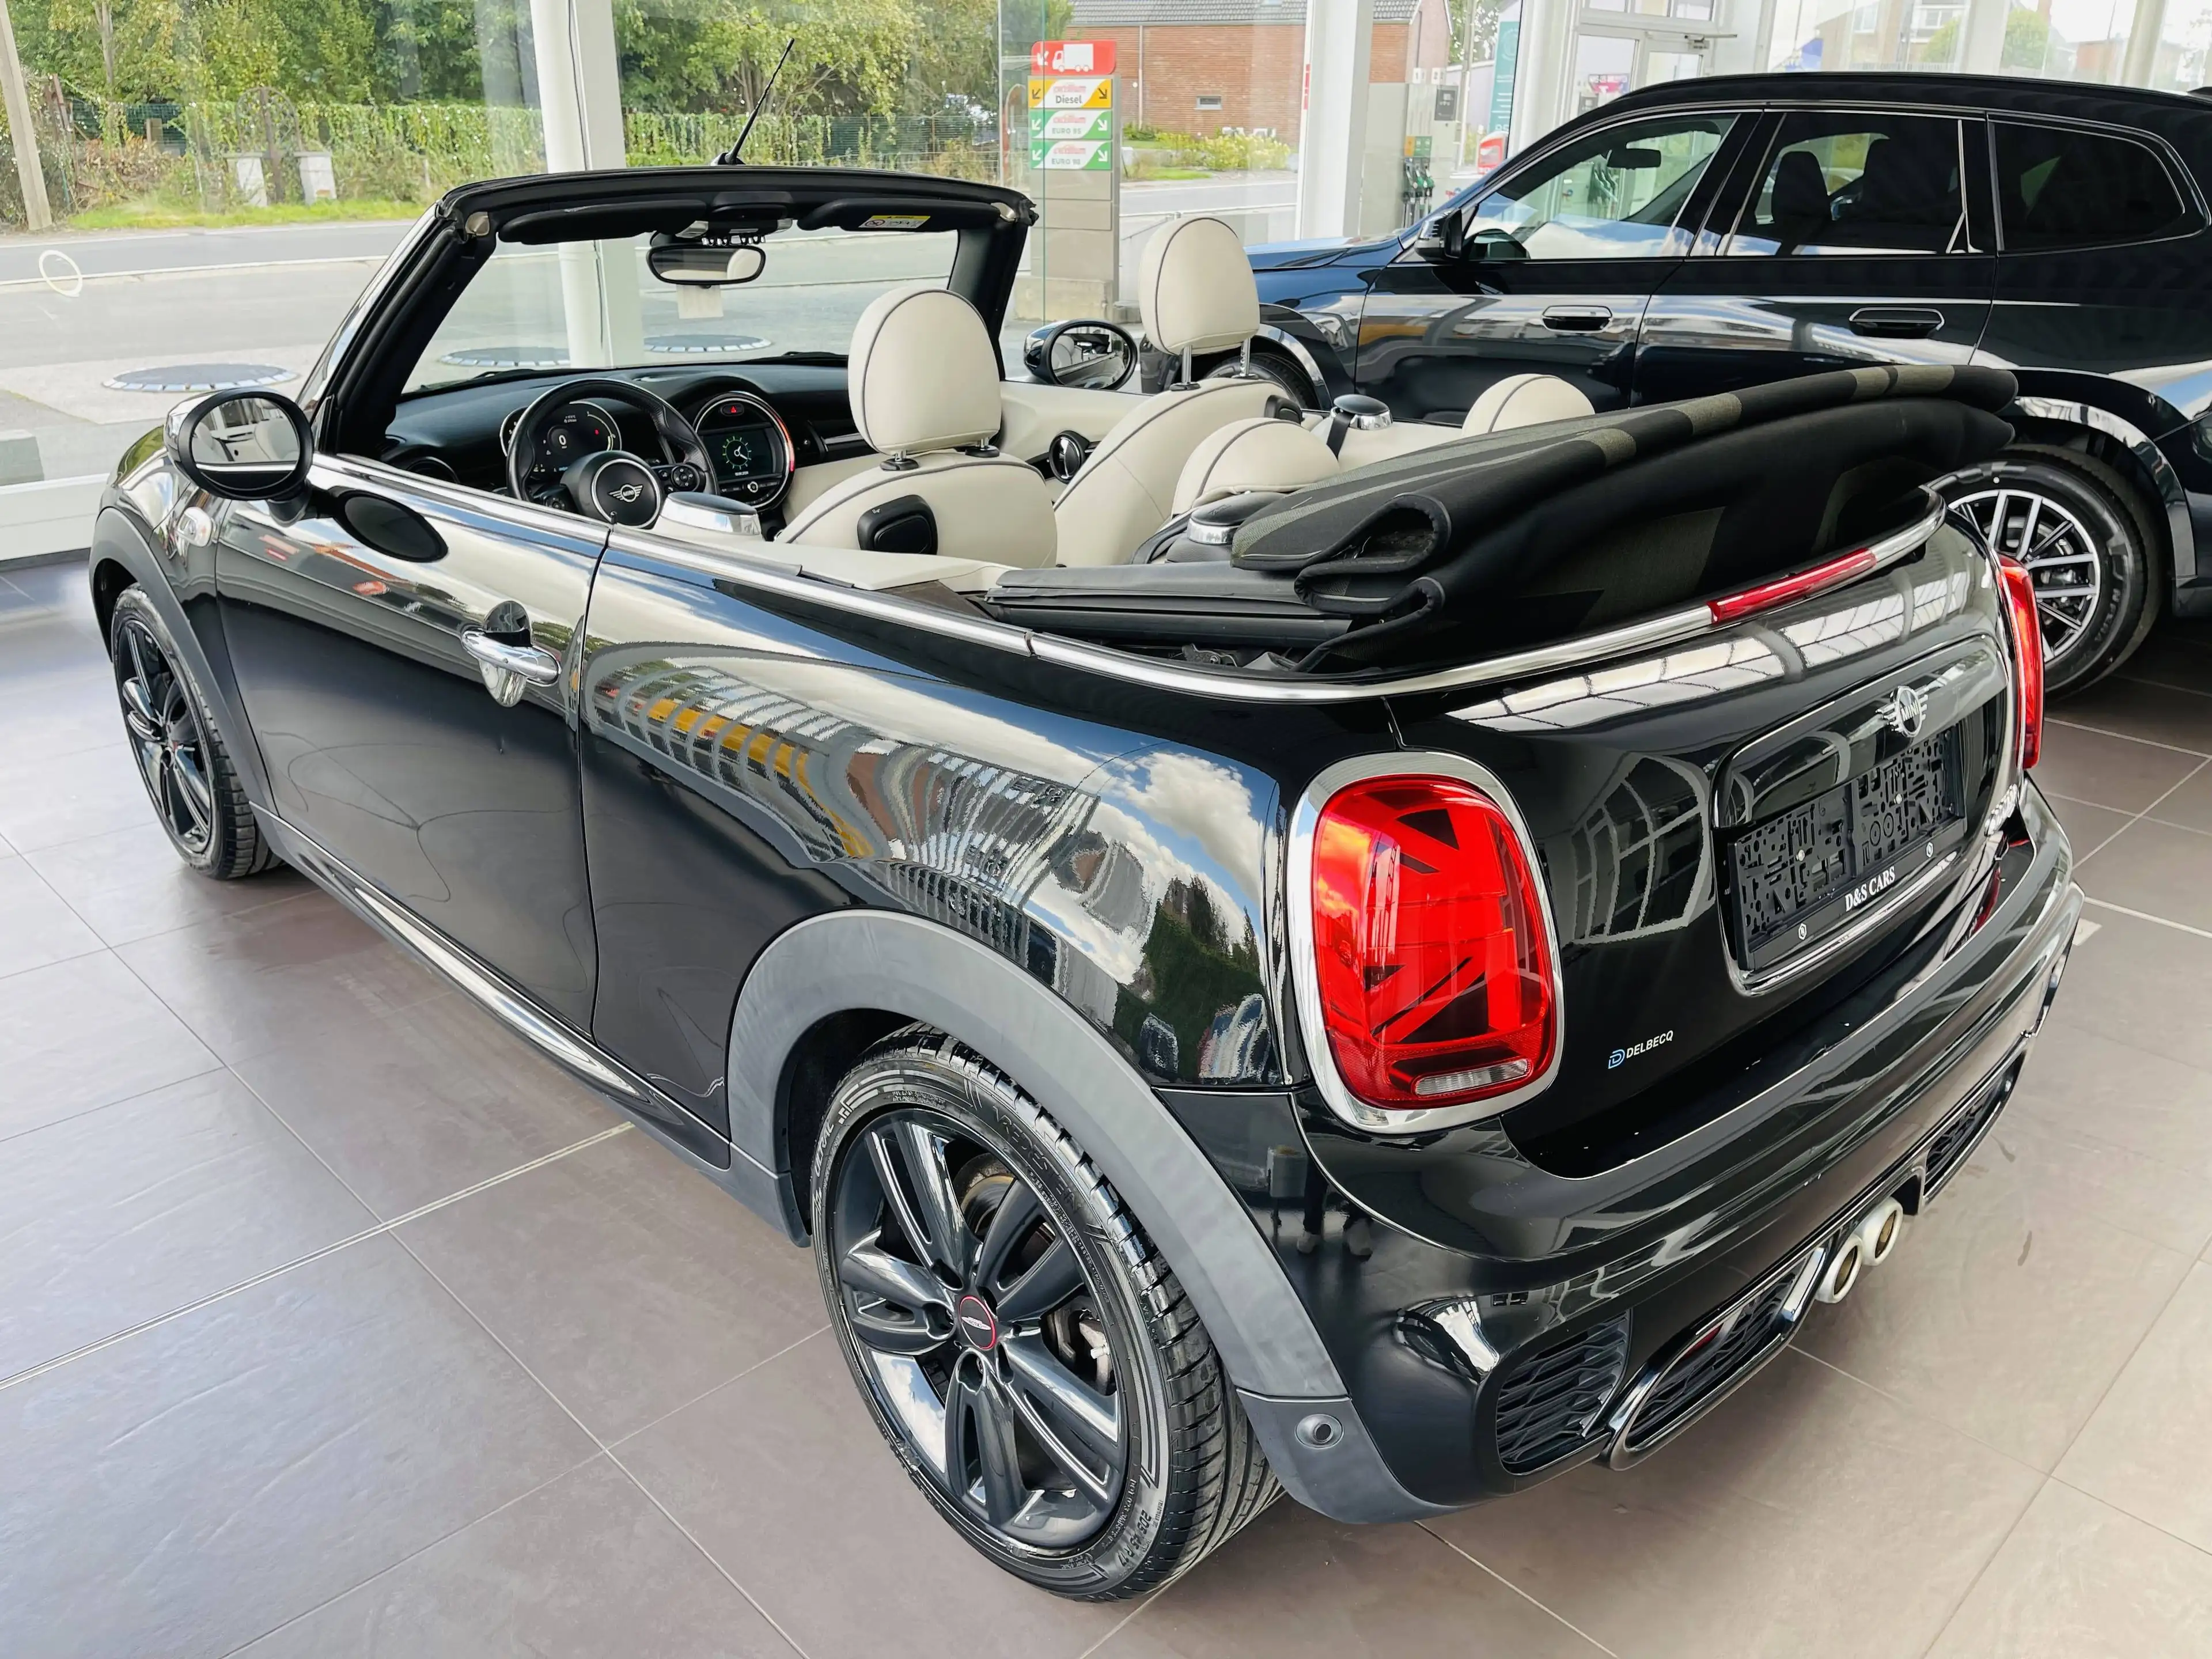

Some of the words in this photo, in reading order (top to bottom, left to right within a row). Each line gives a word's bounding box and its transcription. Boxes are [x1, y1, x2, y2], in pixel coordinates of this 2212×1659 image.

[1055, 94, 1082, 104] Diesel
[558, 434, 567, 446] 0
[1900, 699, 1920, 722] MINI
[1845, 884, 1868, 912] D&S
[1869, 866, 1895, 896] CARS
[1626, 1030, 1674, 1059] DELBECQ
